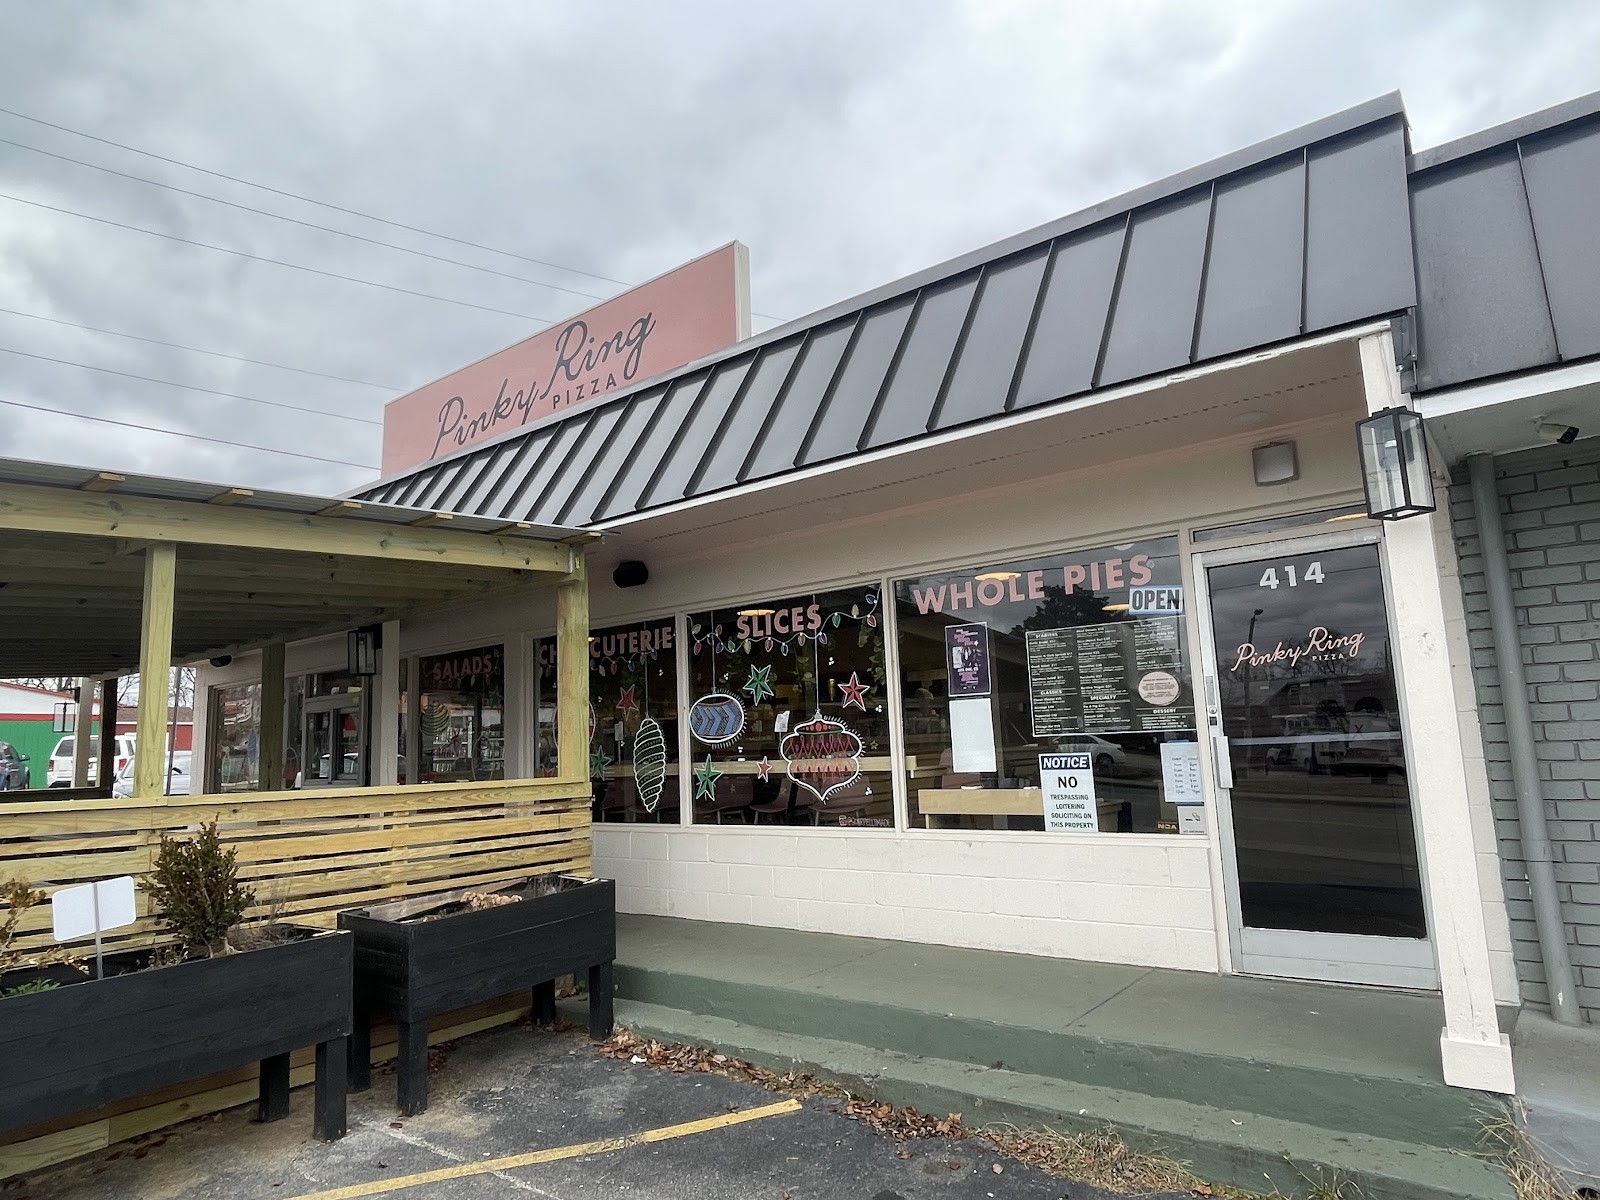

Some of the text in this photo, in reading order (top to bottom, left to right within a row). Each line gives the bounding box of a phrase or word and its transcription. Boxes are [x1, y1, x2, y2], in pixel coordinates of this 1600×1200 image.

[430, 311, 657, 461] Pinky Ring
[552, 373, 617, 410] PIZZA
[912, 554, 1153, 615] WHOLE PIES
[1259, 561, 1326, 590] 414
[1132, 588, 1180, 611] OPEN
[736, 604, 822, 640] SLICES
[1230, 626, 1366, 672] Pinky Ring
[1312, 653, 1344, 662] PIZZA
[432, 654, 492, 682] SALADS
[1042, 755, 1088, 769] NOTICE
[1057, 776, 1078, 789] NO
[1050, 821, 1063, 829] THIS
